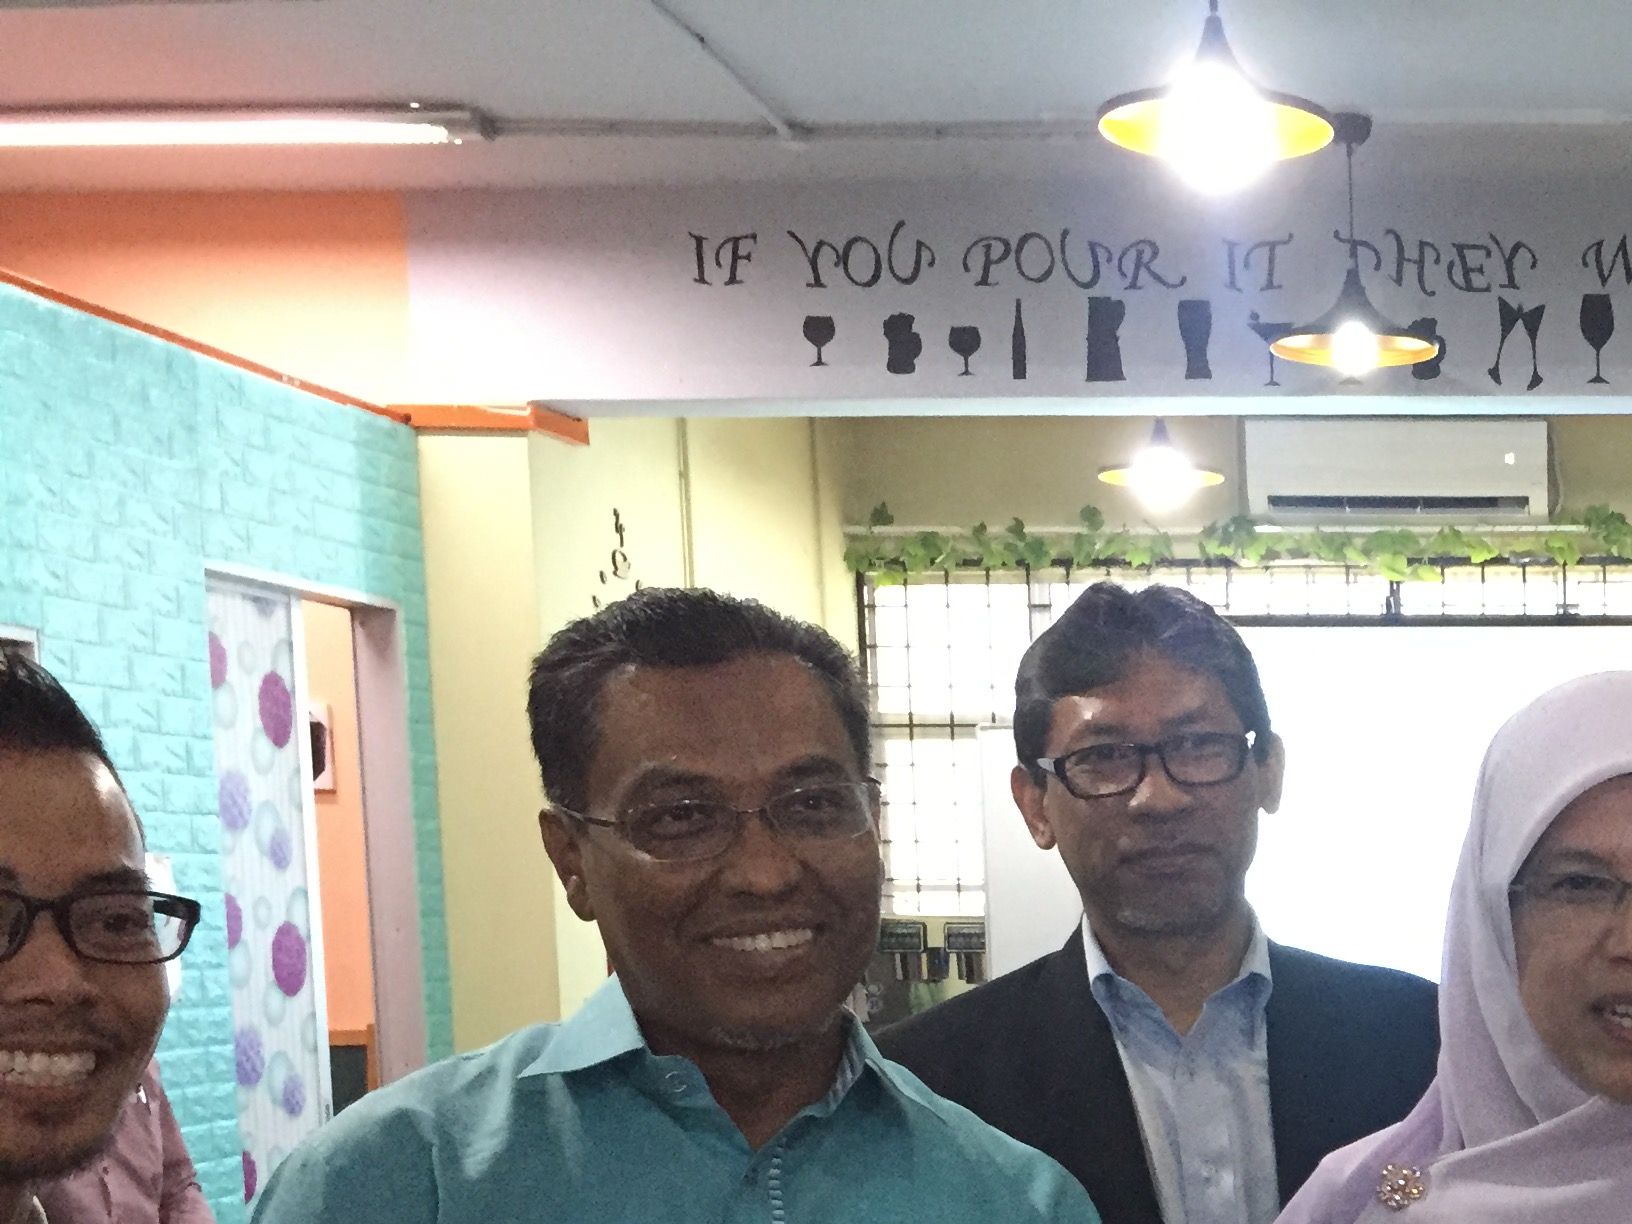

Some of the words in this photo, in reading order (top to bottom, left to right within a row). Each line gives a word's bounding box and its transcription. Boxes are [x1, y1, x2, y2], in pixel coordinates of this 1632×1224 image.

[688, 231, 758, 287] IF
[787, 220, 936, 288] YOU
[962, 228, 1187, 290] POUR
[1226, 232, 1294, 291] IT
[1333, 228, 1539, 297] THEY
